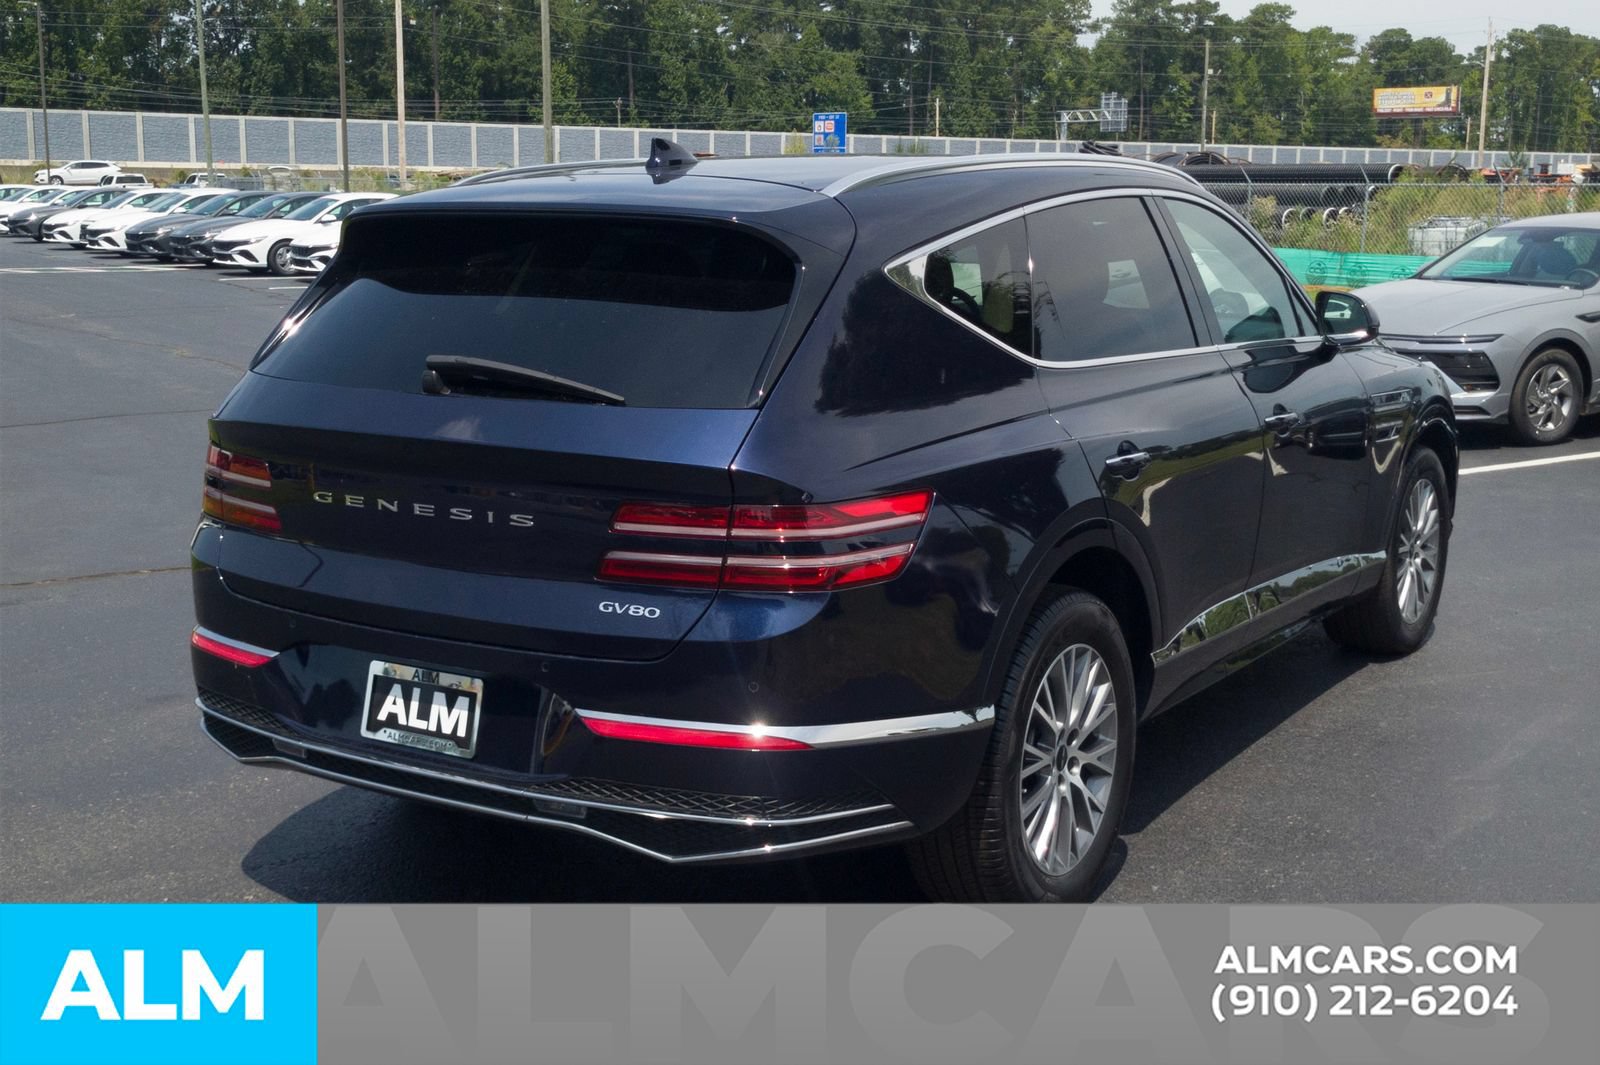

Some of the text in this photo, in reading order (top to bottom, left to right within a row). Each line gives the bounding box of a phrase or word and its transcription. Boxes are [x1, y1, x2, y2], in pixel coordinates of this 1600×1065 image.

[313, 491, 535, 528] GENESIS
[598, 601, 661, 620] GV80
[411, 669, 440, 686] ALM
[376, 683, 470, 738] ALM
[386, 731, 449, 752] ALMCA.COM
